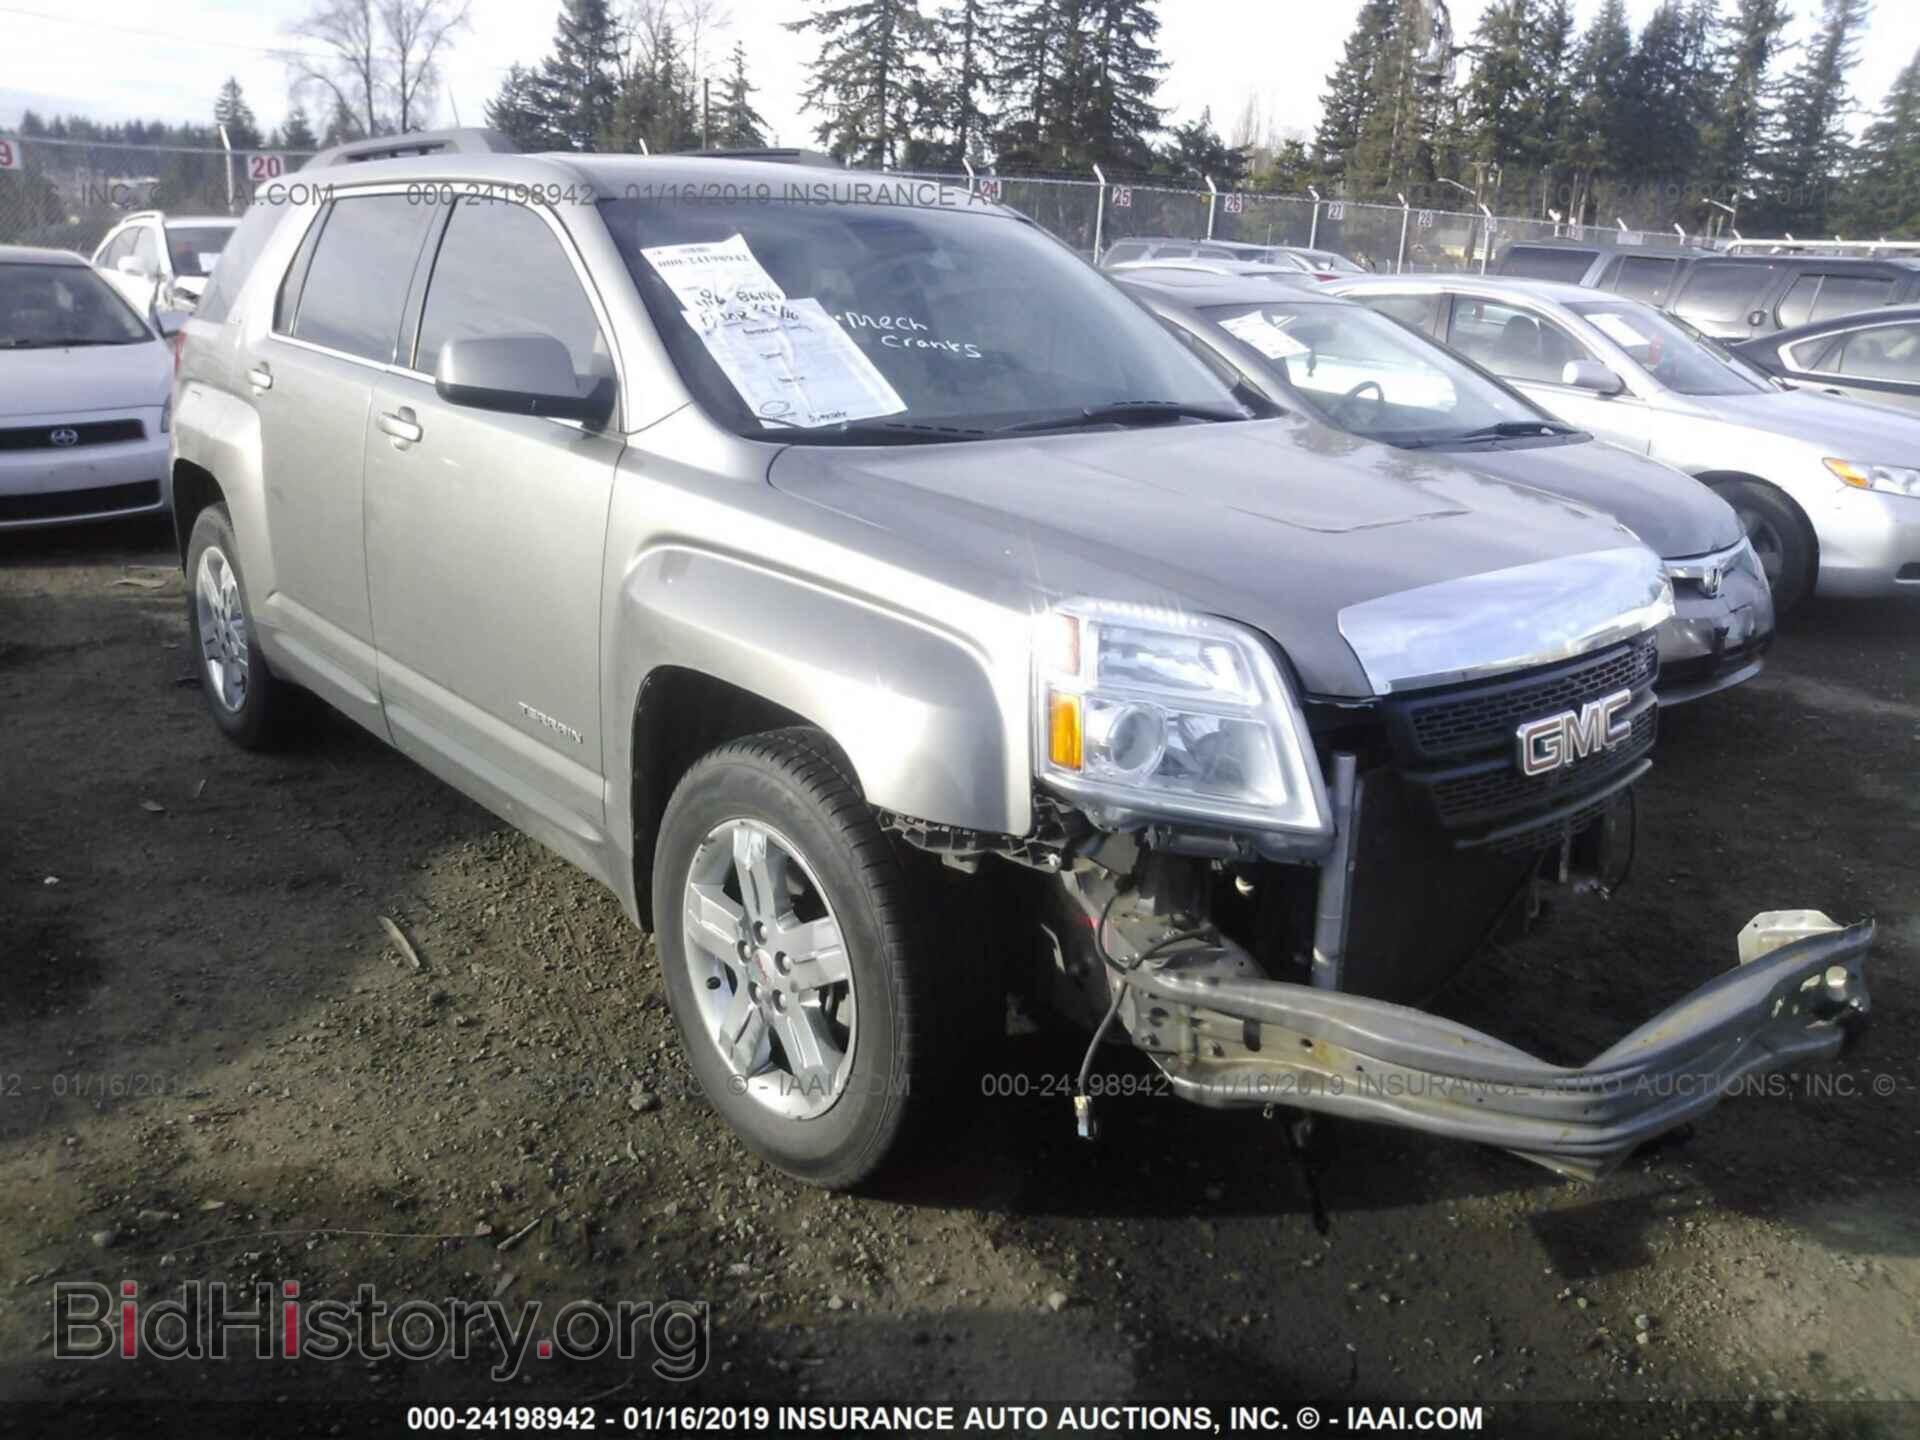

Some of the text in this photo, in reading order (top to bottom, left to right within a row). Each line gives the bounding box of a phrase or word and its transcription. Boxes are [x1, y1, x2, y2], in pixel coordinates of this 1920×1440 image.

[251, 156, 281, 178] 20
[518, 701, 584, 745] TERRAIN
[1516, 687, 1632, 776] GMC
